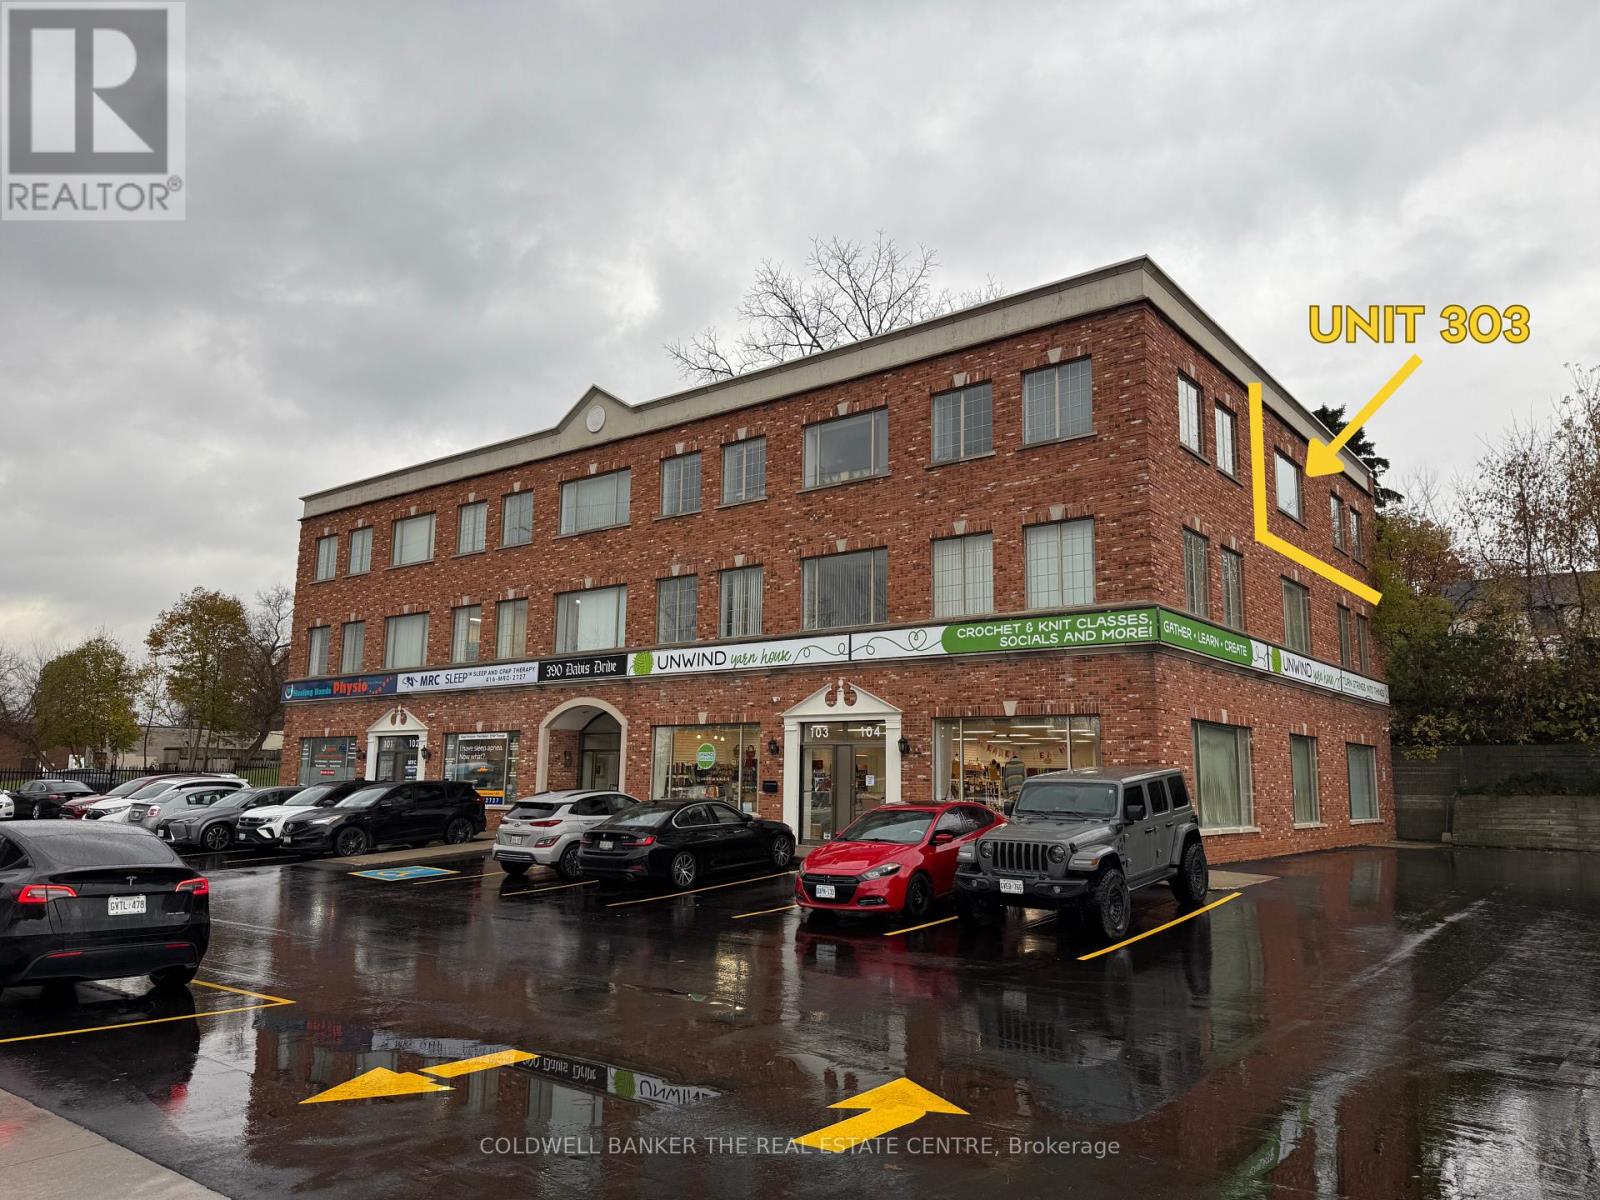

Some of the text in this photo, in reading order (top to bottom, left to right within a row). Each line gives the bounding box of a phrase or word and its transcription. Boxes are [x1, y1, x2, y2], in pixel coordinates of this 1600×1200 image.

[957, 624, 1021, 638] CROCHET
[1026, 621, 1034, 633] &
[1038, 619, 1072, 631] KNIT
[1000, 626, 1153, 647] SOCIALS AND MORE!
[1163, 620, 1248, 657] GATHER LEARN CREATE
[657, 648, 792, 670] UNWIND yarn house
[546, 660, 617, 677] 390 Davis Drive
[1283, 656, 1312, 678] UNWIND
[420, 674, 440, 687] MRC
[333, 681, 368, 695] Physio
[810, 727, 829, 738] 103
[860, 726, 881, 737] 104
[383, 740, 393, 749] 101
[409, 739, 419, 748] 102
[131, 899, 145, 909] 478
